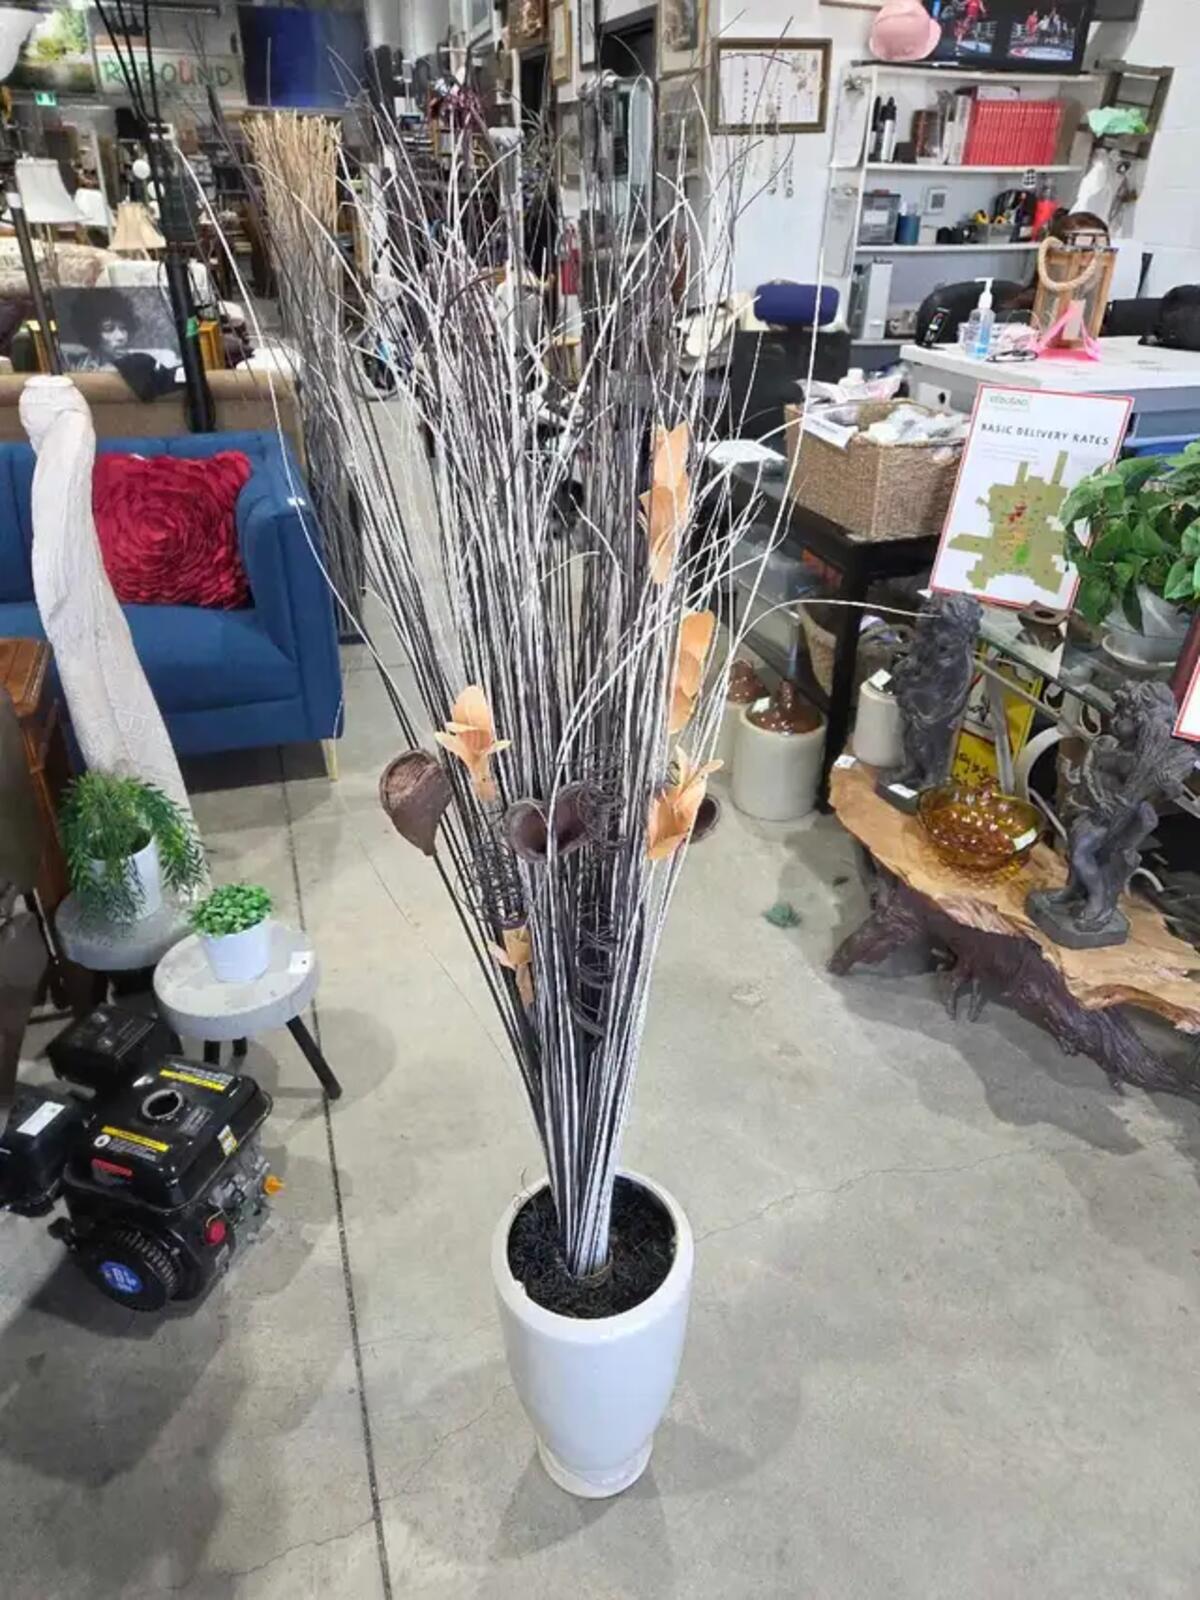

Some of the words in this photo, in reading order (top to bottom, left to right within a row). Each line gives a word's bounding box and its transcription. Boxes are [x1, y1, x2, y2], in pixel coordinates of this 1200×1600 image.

[980, 423, 1013, 435] BASIC
[1016, 427, 1069, 440] DELIVERY
[1073, 433, 1109, 446] RATES
